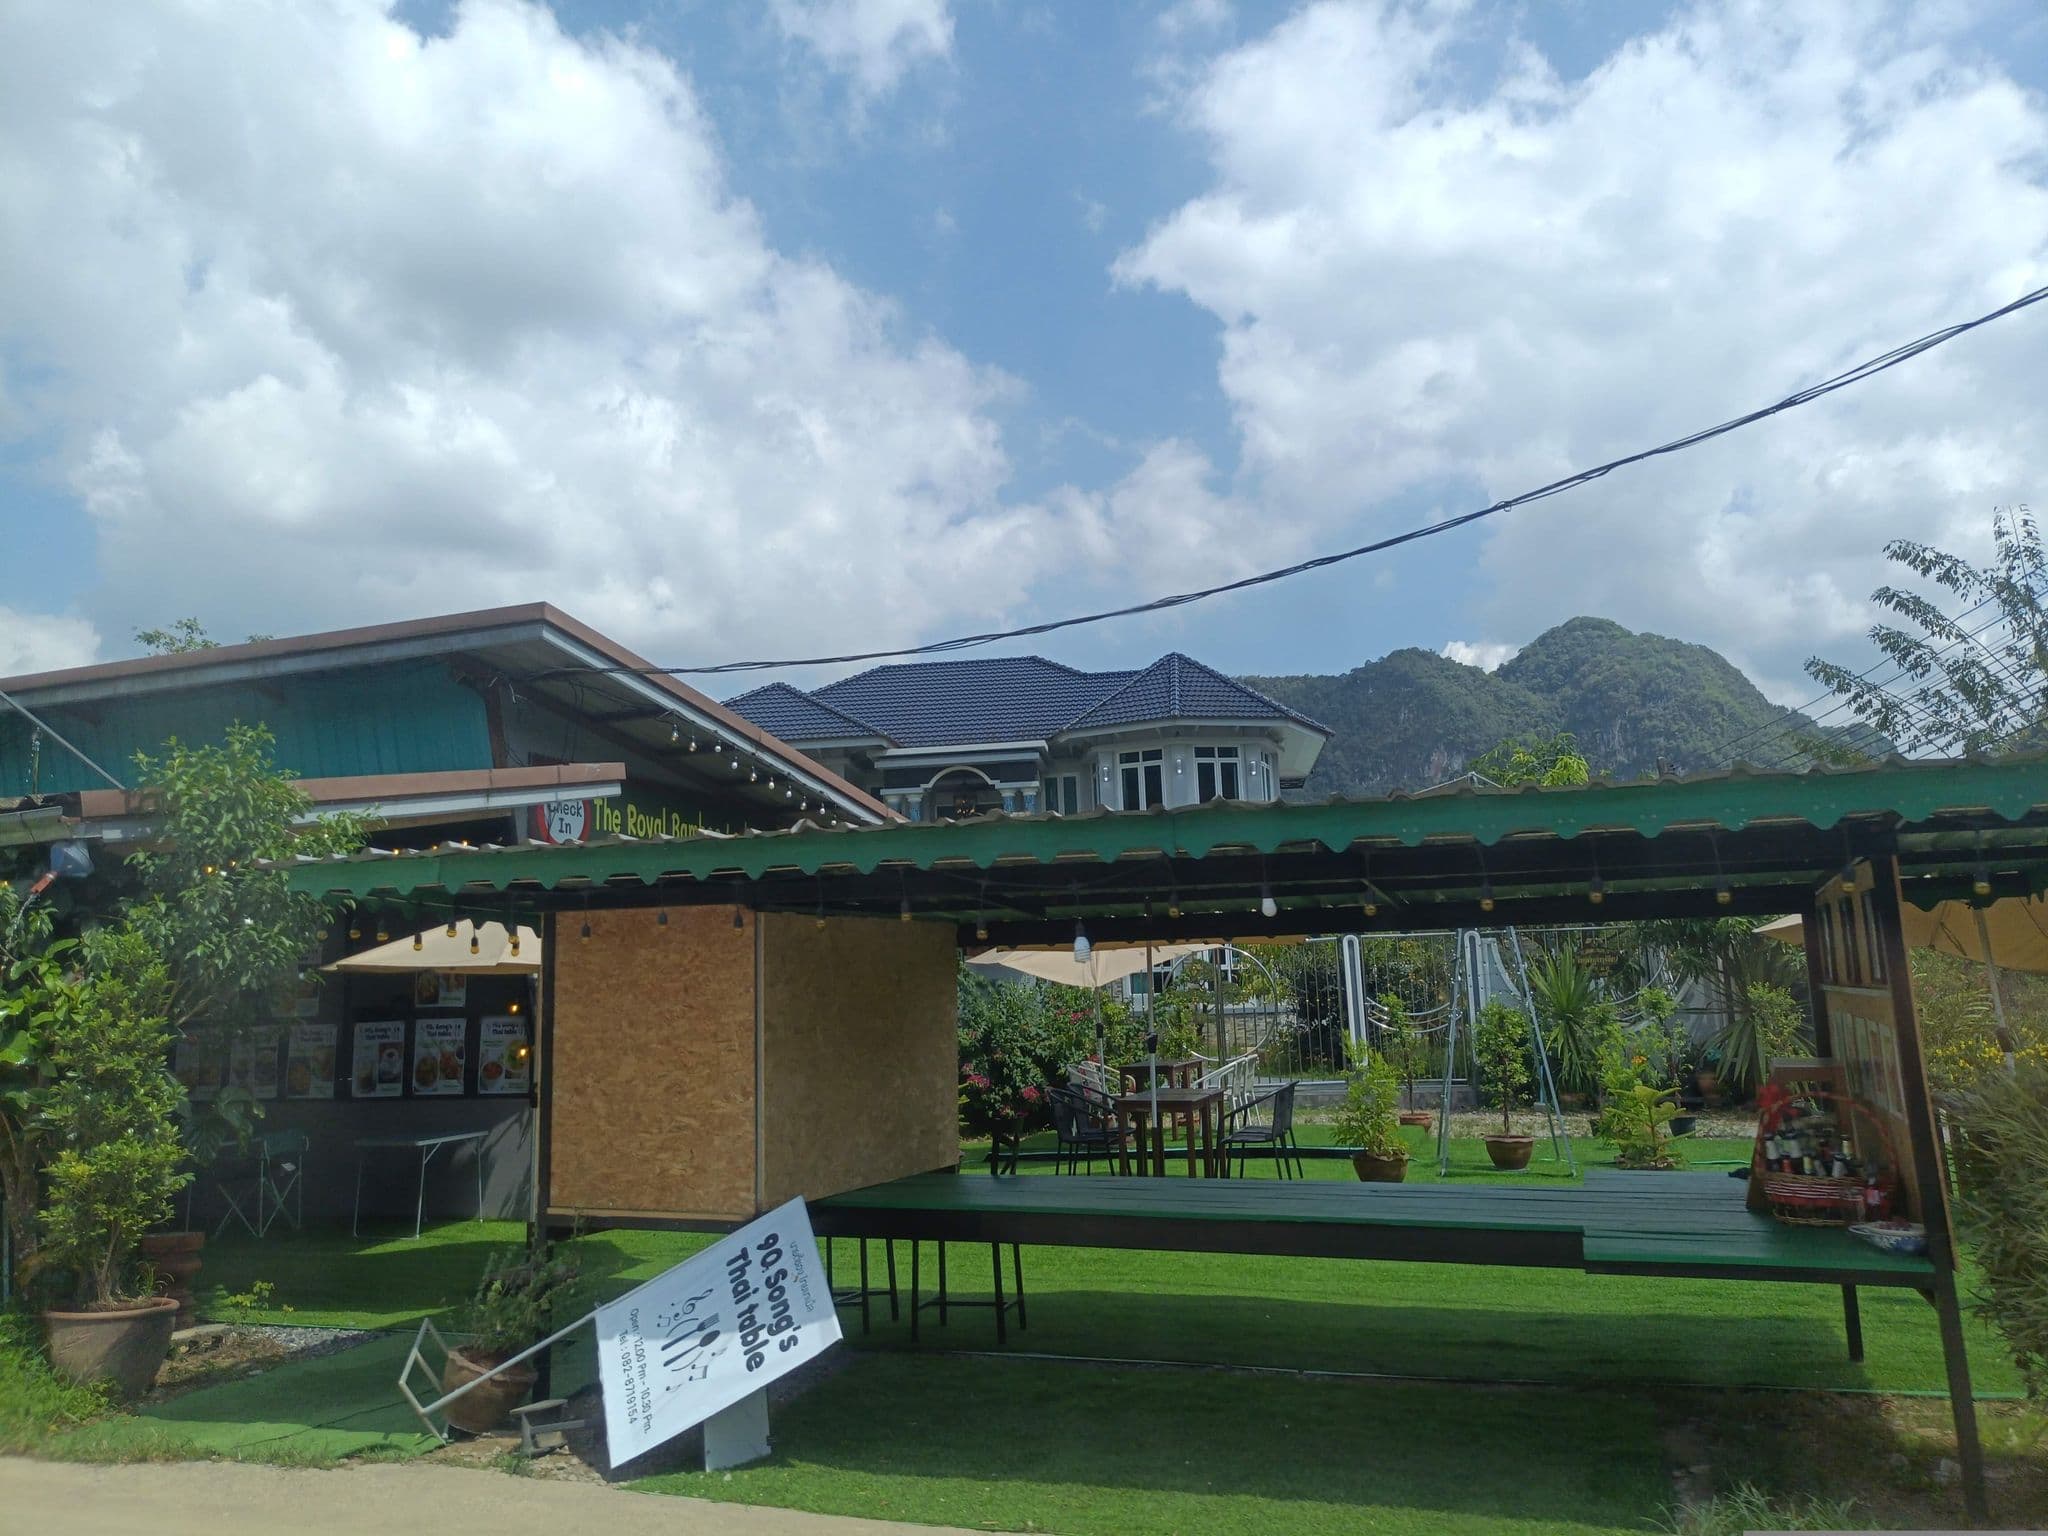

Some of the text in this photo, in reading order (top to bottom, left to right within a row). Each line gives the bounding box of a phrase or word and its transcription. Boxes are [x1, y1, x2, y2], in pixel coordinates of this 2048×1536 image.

[558, 817, 572, 834] In
[593, 797, 621, 833] The
[627, 803, 666, 839] Royal
[629, 1308, 640, 1332] Open
[726, 1247, 770, 1372] Thai table
[765, 1268, 801, 1352] Song's
